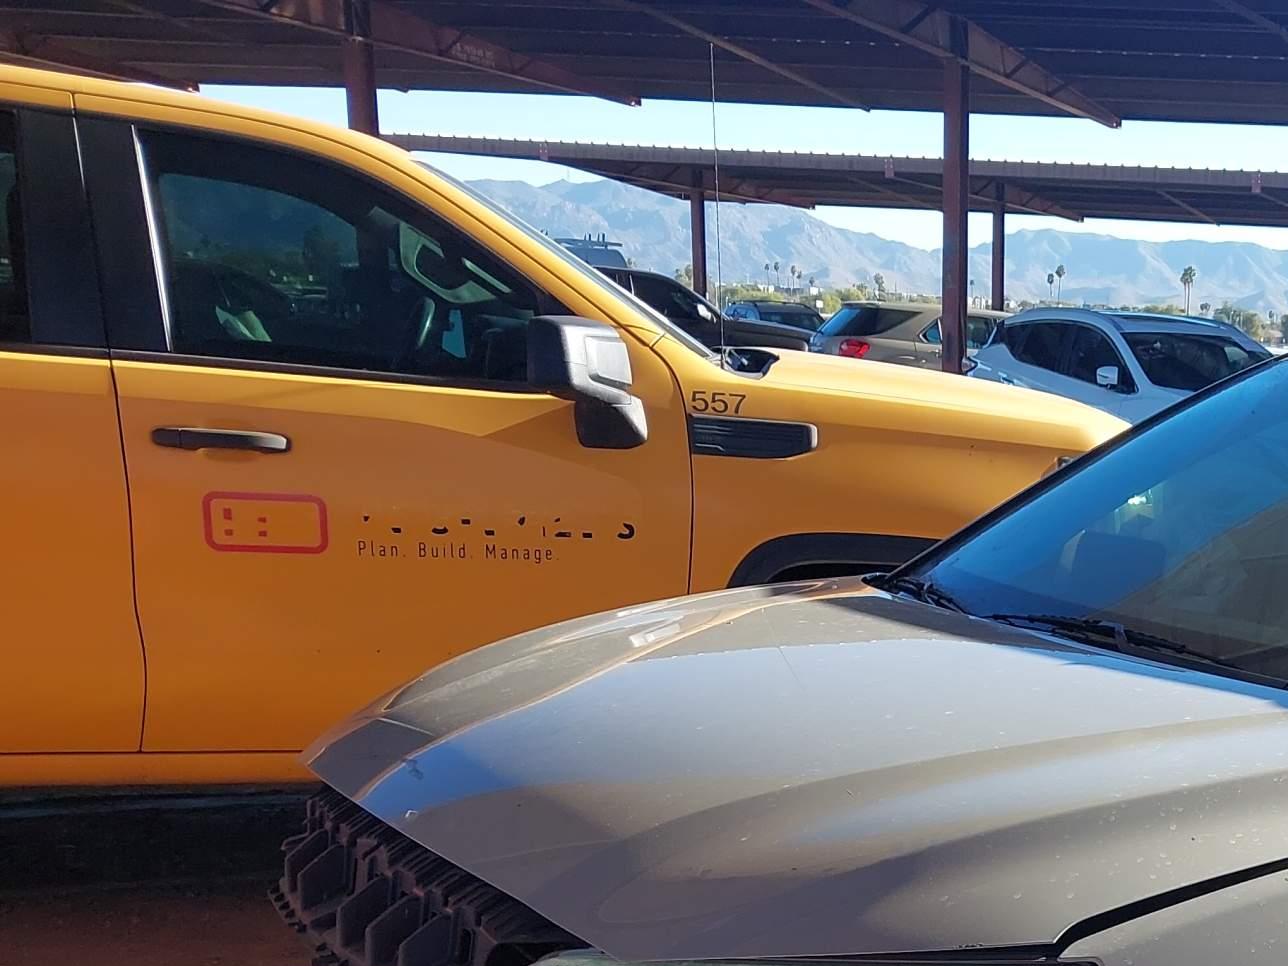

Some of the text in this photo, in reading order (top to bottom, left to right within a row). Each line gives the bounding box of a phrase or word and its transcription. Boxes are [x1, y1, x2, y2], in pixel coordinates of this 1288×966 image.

[691, 390, 747, 414] 557
[357, 540, 560, 564] Plan. Build. Manage.
